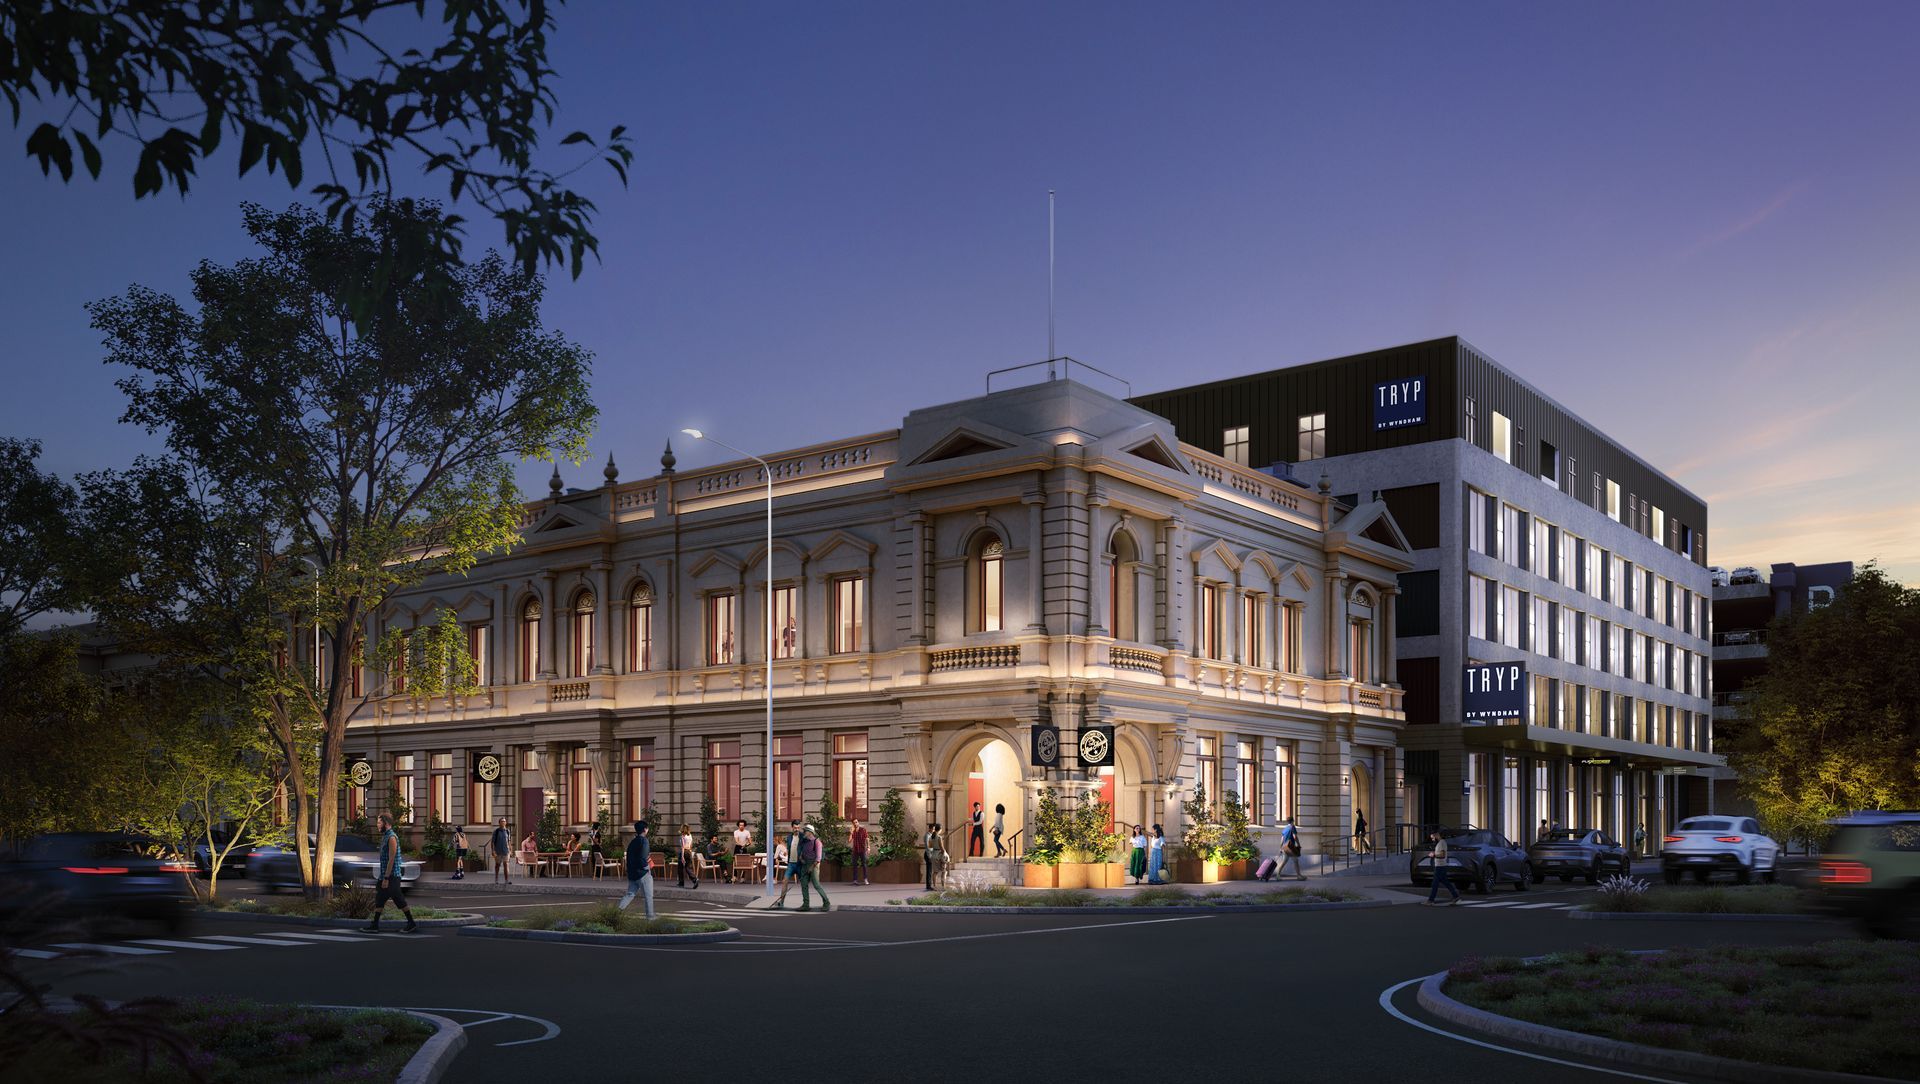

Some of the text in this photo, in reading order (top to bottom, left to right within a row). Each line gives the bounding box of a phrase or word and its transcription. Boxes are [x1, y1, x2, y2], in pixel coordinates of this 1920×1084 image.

[1378, 380, 1421, 407] TRYP
[1389, 417, 1421, 426] WYNDHAM
[1467, 666, 1519, 693] TRYP
[1480, 709, 1519, 717] WYNDHAM
